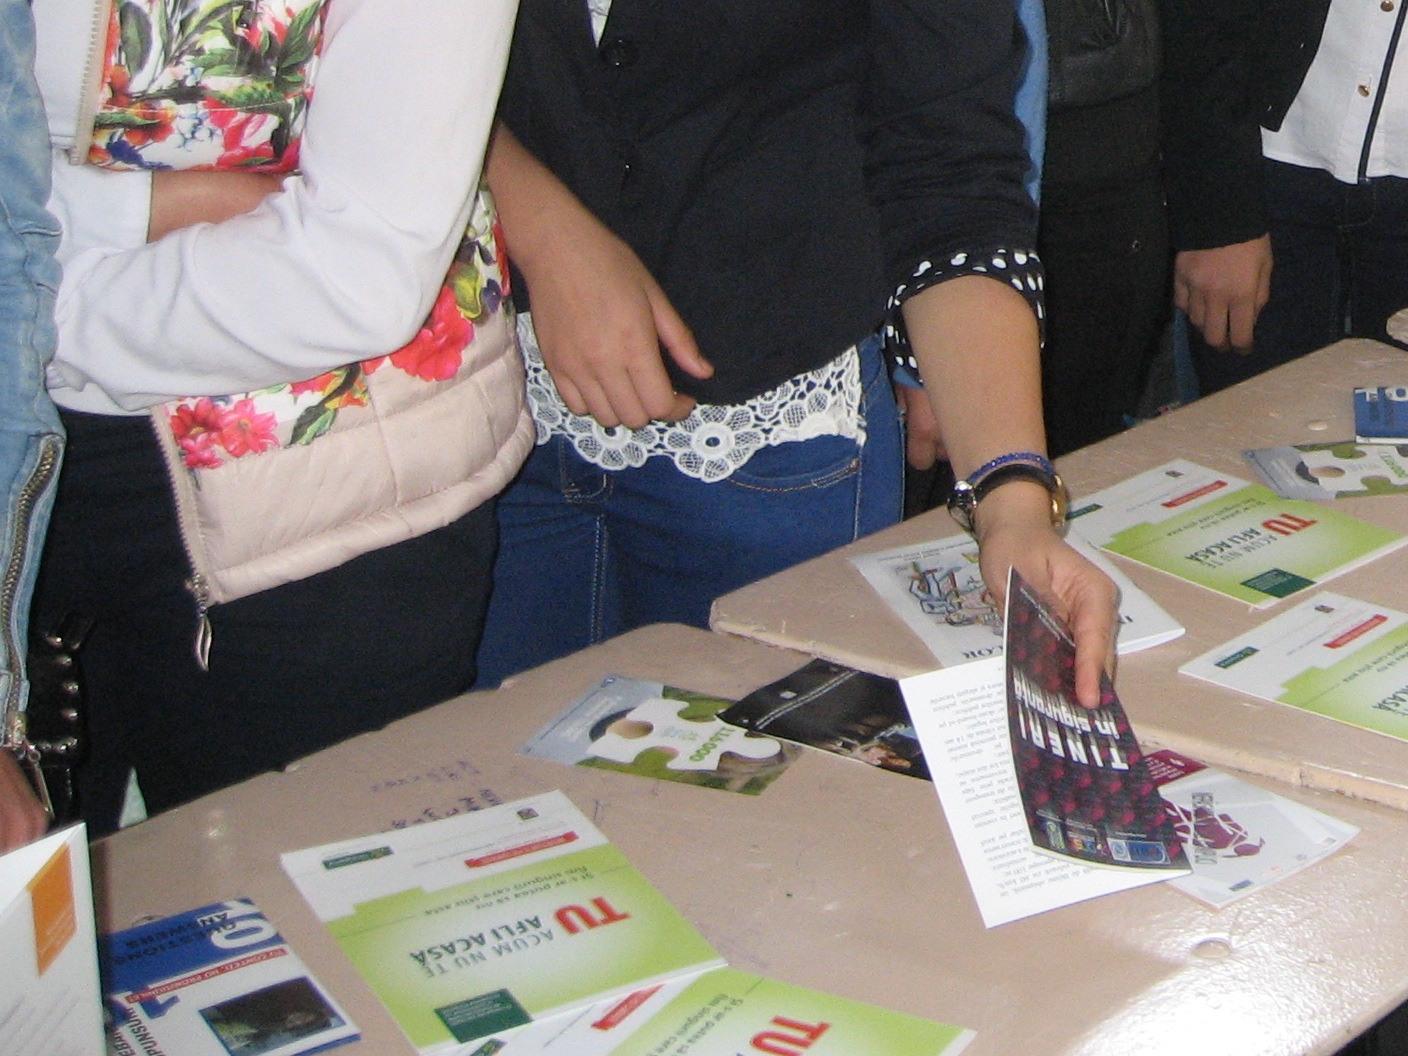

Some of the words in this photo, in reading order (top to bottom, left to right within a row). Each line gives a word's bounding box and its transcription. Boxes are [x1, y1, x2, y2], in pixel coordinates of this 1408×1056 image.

[1260, 512, 1318, 536] TU
[1018, 707, 1130, 771] TINERI
[490, 915, 542, 940] AFLI
[553, 896, 633, 935] TU
[491, 927, 554, 958] ACUM
[420, 961, 448, 978] TE
[454, 949, 487, 970] NU
[750, 1014, 832, 1056] TU
